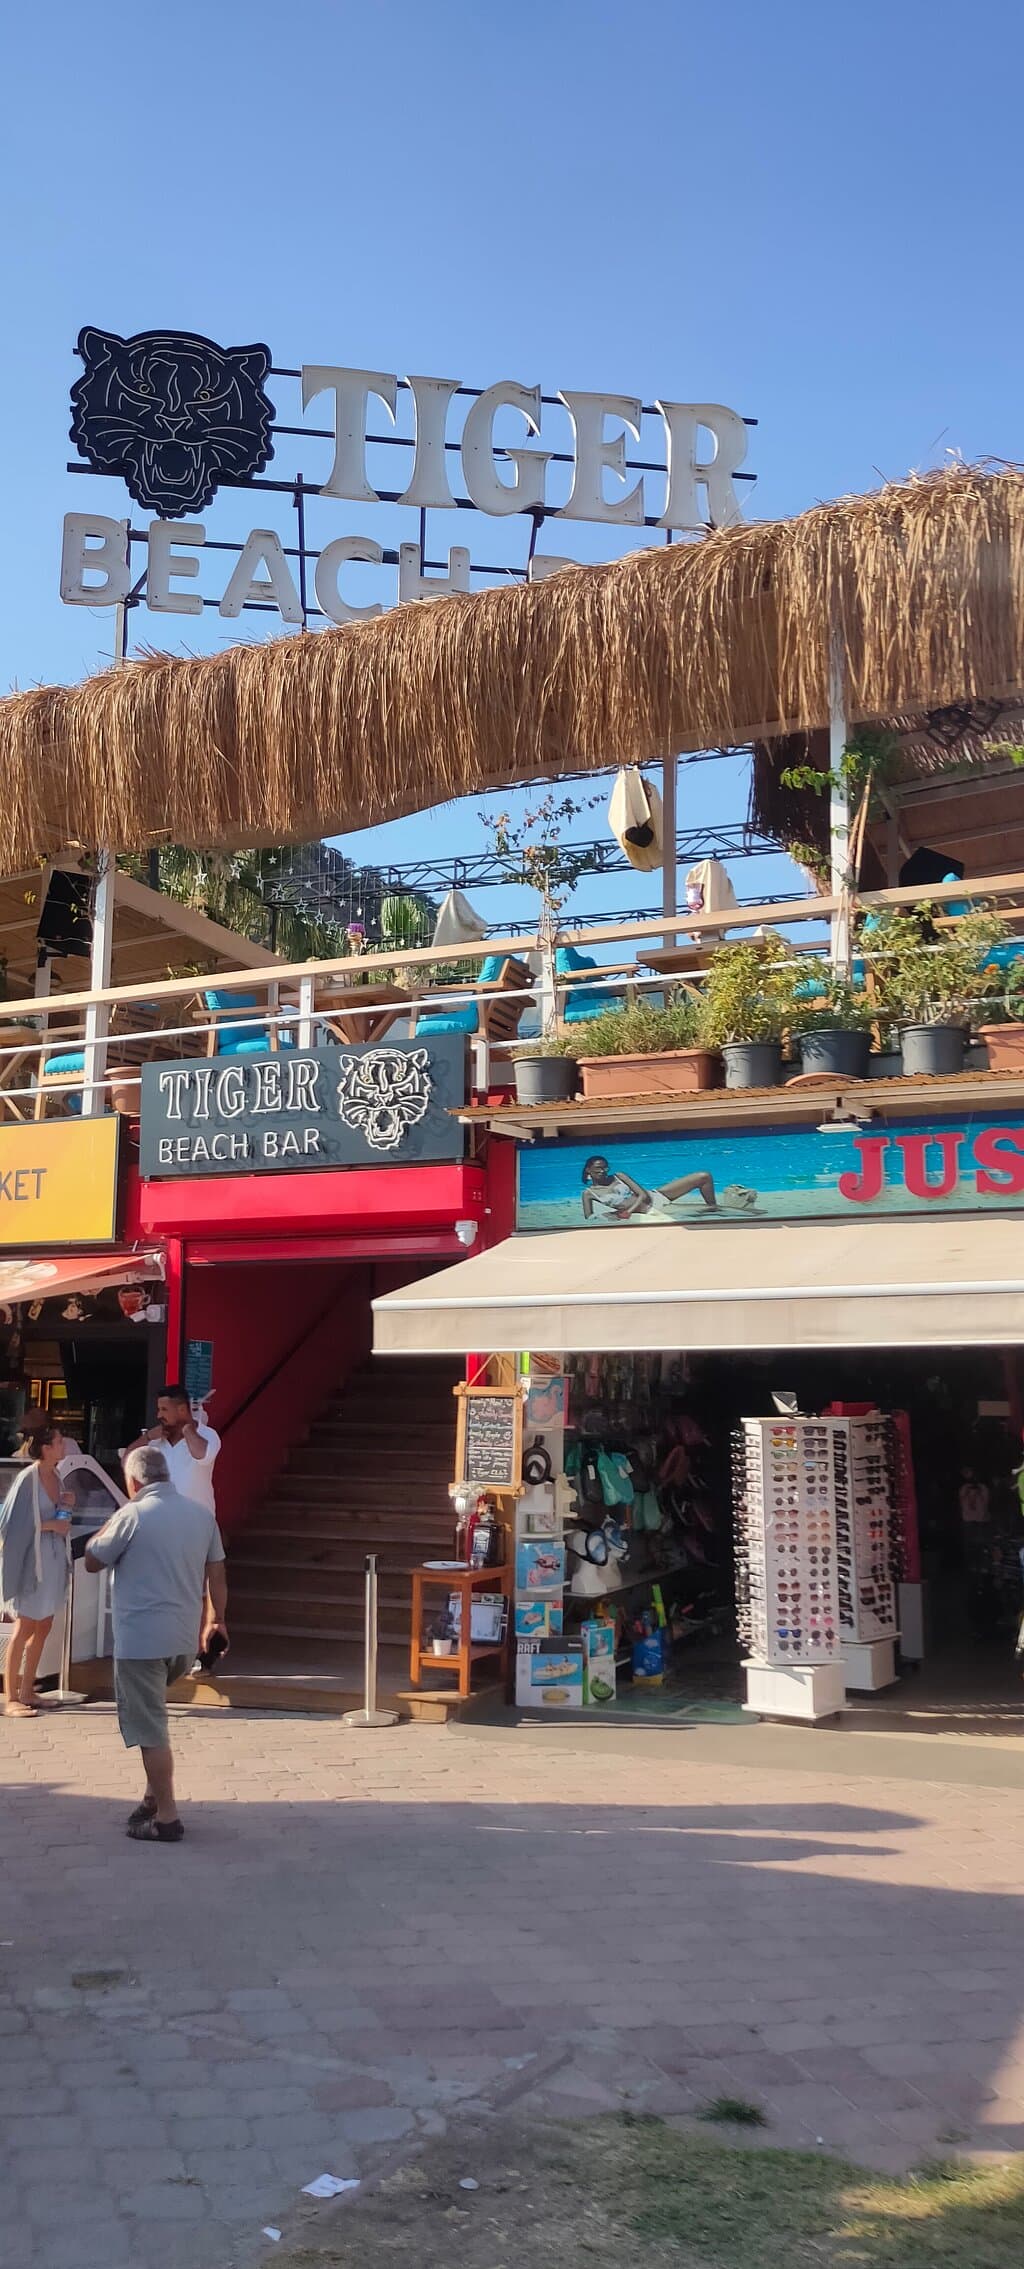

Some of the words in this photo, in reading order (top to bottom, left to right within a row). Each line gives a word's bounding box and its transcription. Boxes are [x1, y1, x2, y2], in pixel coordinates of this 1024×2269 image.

[302, 365, 748, 530] TIGER
[60, 512, 470, 624] BEACH
[159, 1058, 321, 1119] TIGER
[159, 1133, 248, 1164] BEACH
[263, 1128, 321, 1158] BAR
[838, 1128, 1024, 1203] JUS
[0, 1168, 48, 1201] KET
[517, 1643, 541, 1654] RAFT
